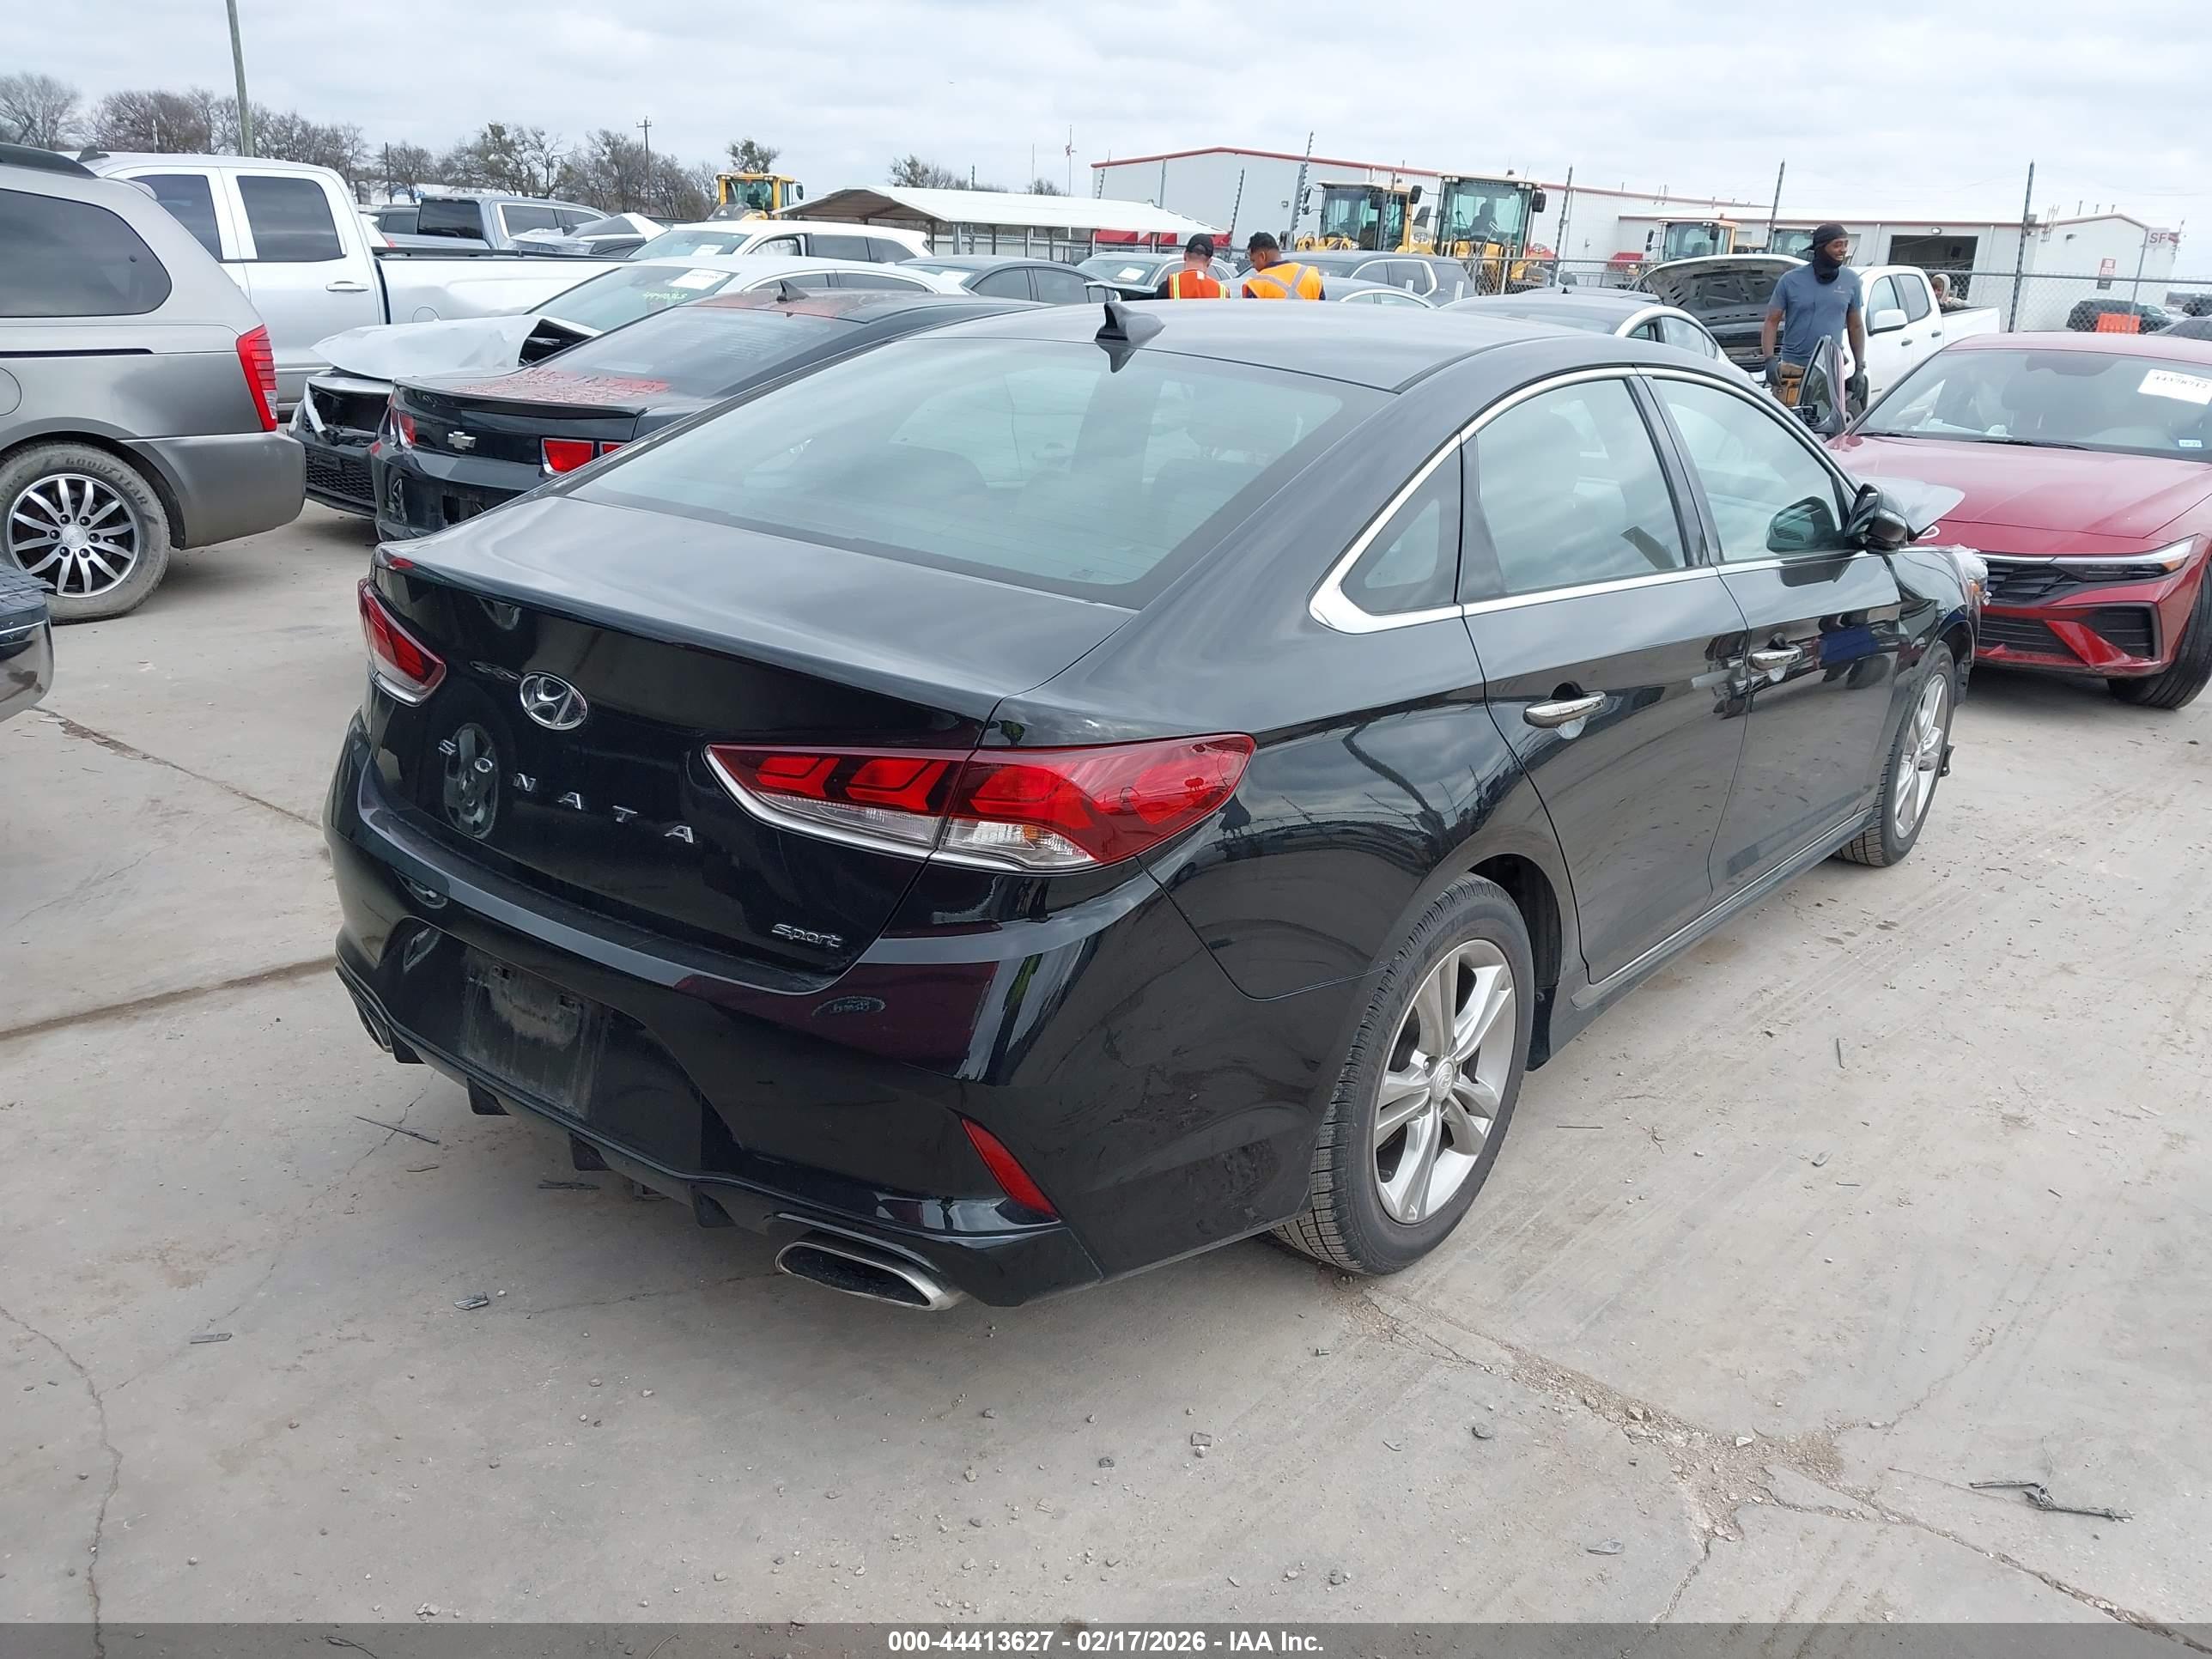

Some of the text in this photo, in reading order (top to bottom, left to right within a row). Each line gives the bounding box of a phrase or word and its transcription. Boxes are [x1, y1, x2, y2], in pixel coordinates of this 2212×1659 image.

[2148, 233, 2167, 244] SF
[65, 456, 149, 506] GOODYEAR
[438, 738, 696, 844] SONATA
[770, 923, 844, 948] Sport
